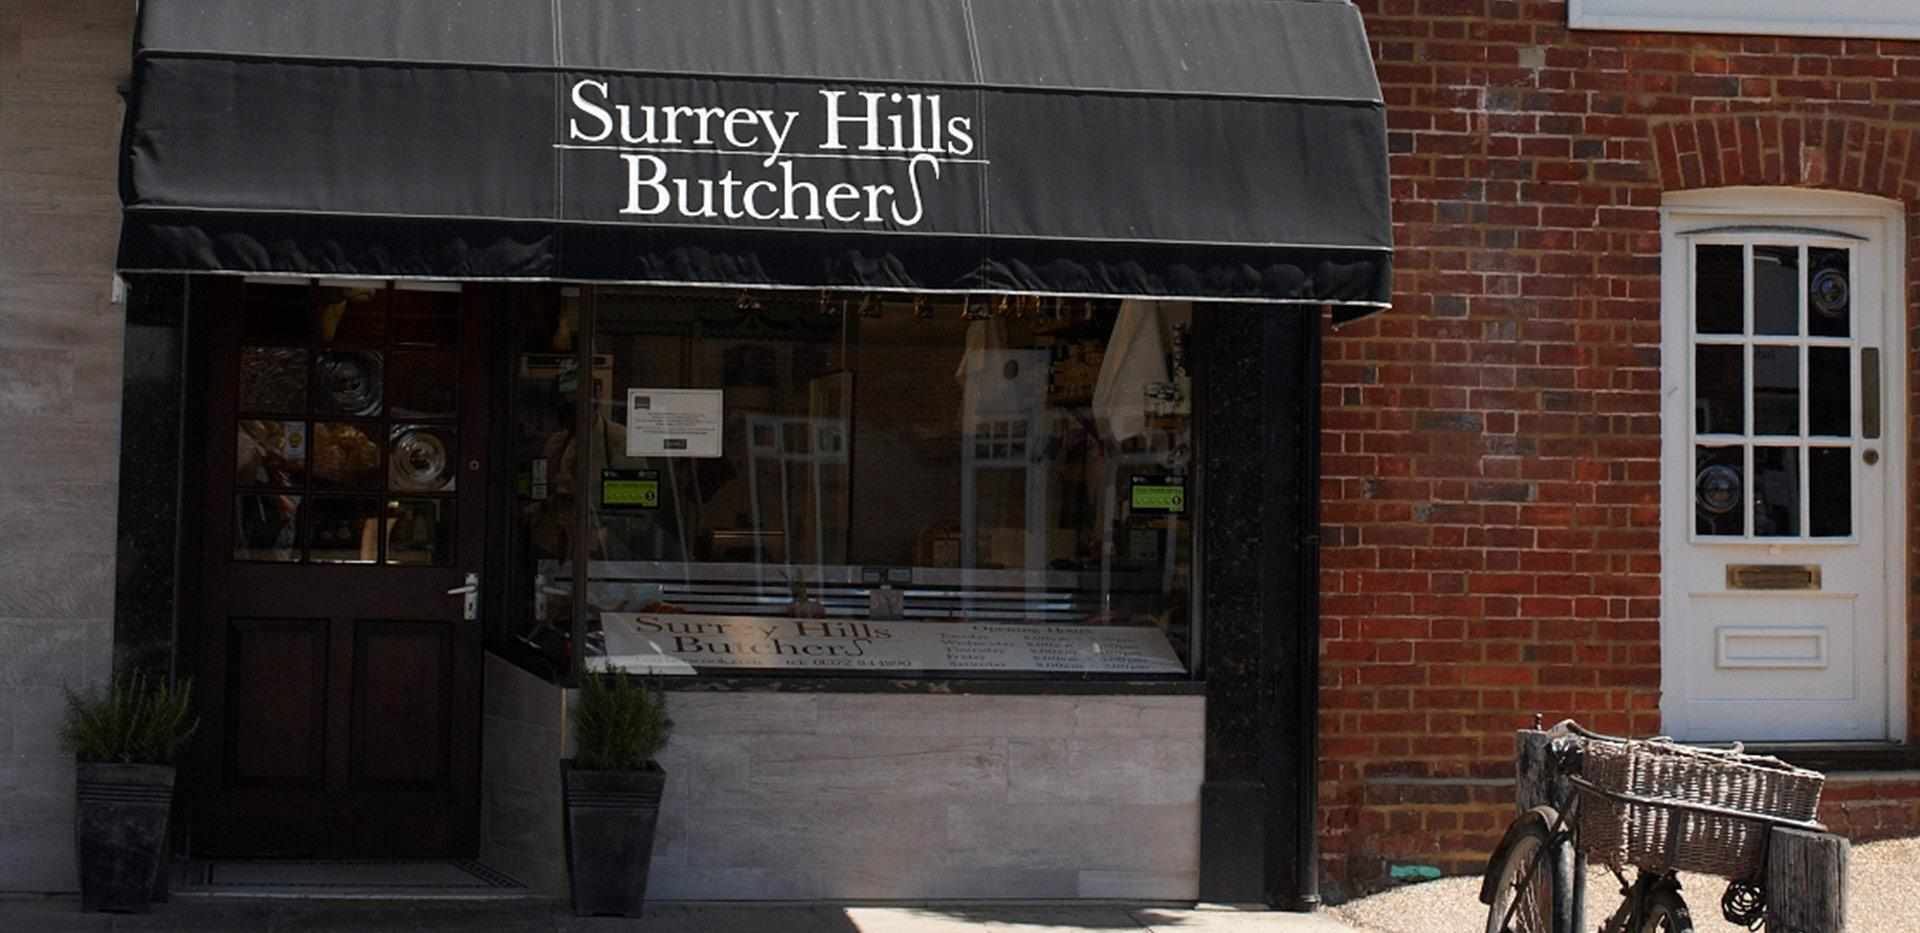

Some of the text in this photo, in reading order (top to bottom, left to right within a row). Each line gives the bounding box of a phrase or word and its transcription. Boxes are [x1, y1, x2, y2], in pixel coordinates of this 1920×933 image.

[569, 79, 974, 168] Surrey Hills
[619, 153, 940, 227] Butchers
[790, 620, 893, 640] Hills
